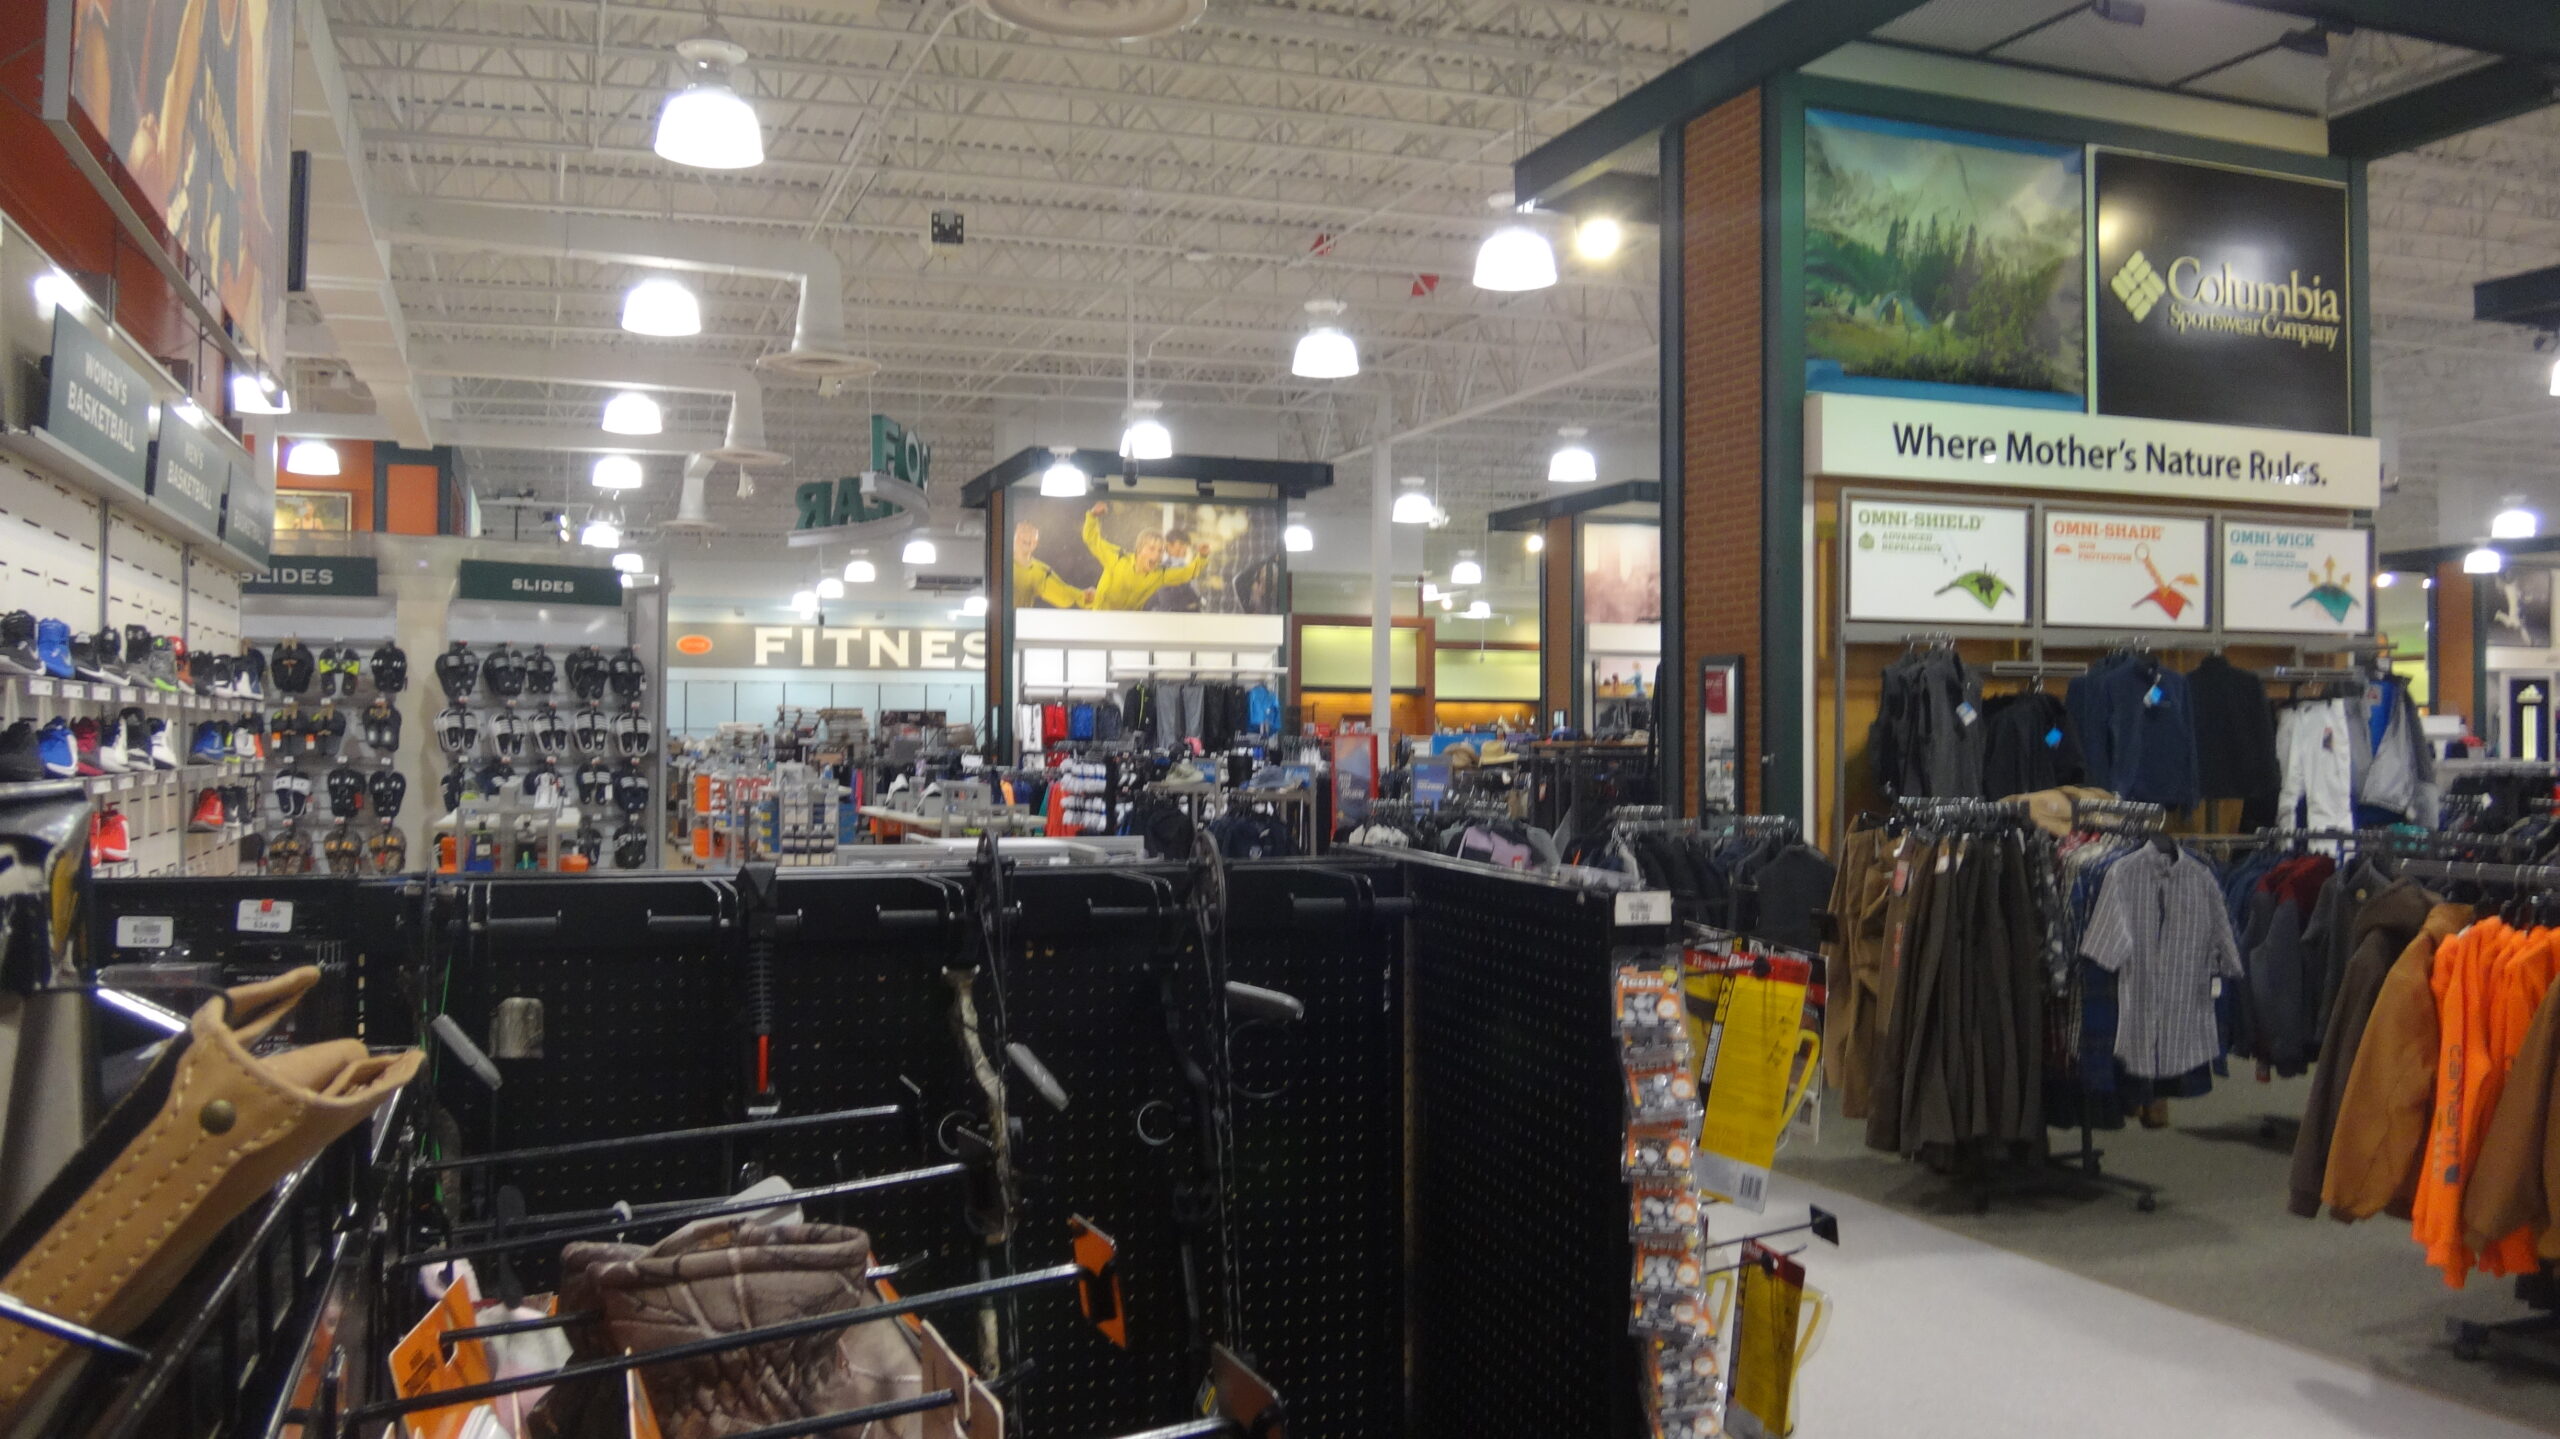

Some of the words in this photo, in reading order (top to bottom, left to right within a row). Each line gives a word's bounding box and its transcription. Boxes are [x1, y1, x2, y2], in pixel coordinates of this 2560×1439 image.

[2167, 256, 2341, 322] Columbia
[2169, 302, 2260, 337] Sportswear
[2261, 313, 2338, 352] Company
[84, 351, 128, 407] WOMEN'S
[67, 380, 136, 454] BASKETBALL
[1893, 422, 1998, 461] Where
[2005, 431, 2137, 472] Mother's
[2146, 441, 2241, 480] Nature
[166, 459, 213, 511] BASKETBALL
[1858, 509, 1982, 531] OMNI-SHIELD
[2053, 519, 2161, 541] OMNI-SHADE
[2230, 529, 2315, 548] OMNI-WICK
[511, 578, 575, 594] SLIDES
